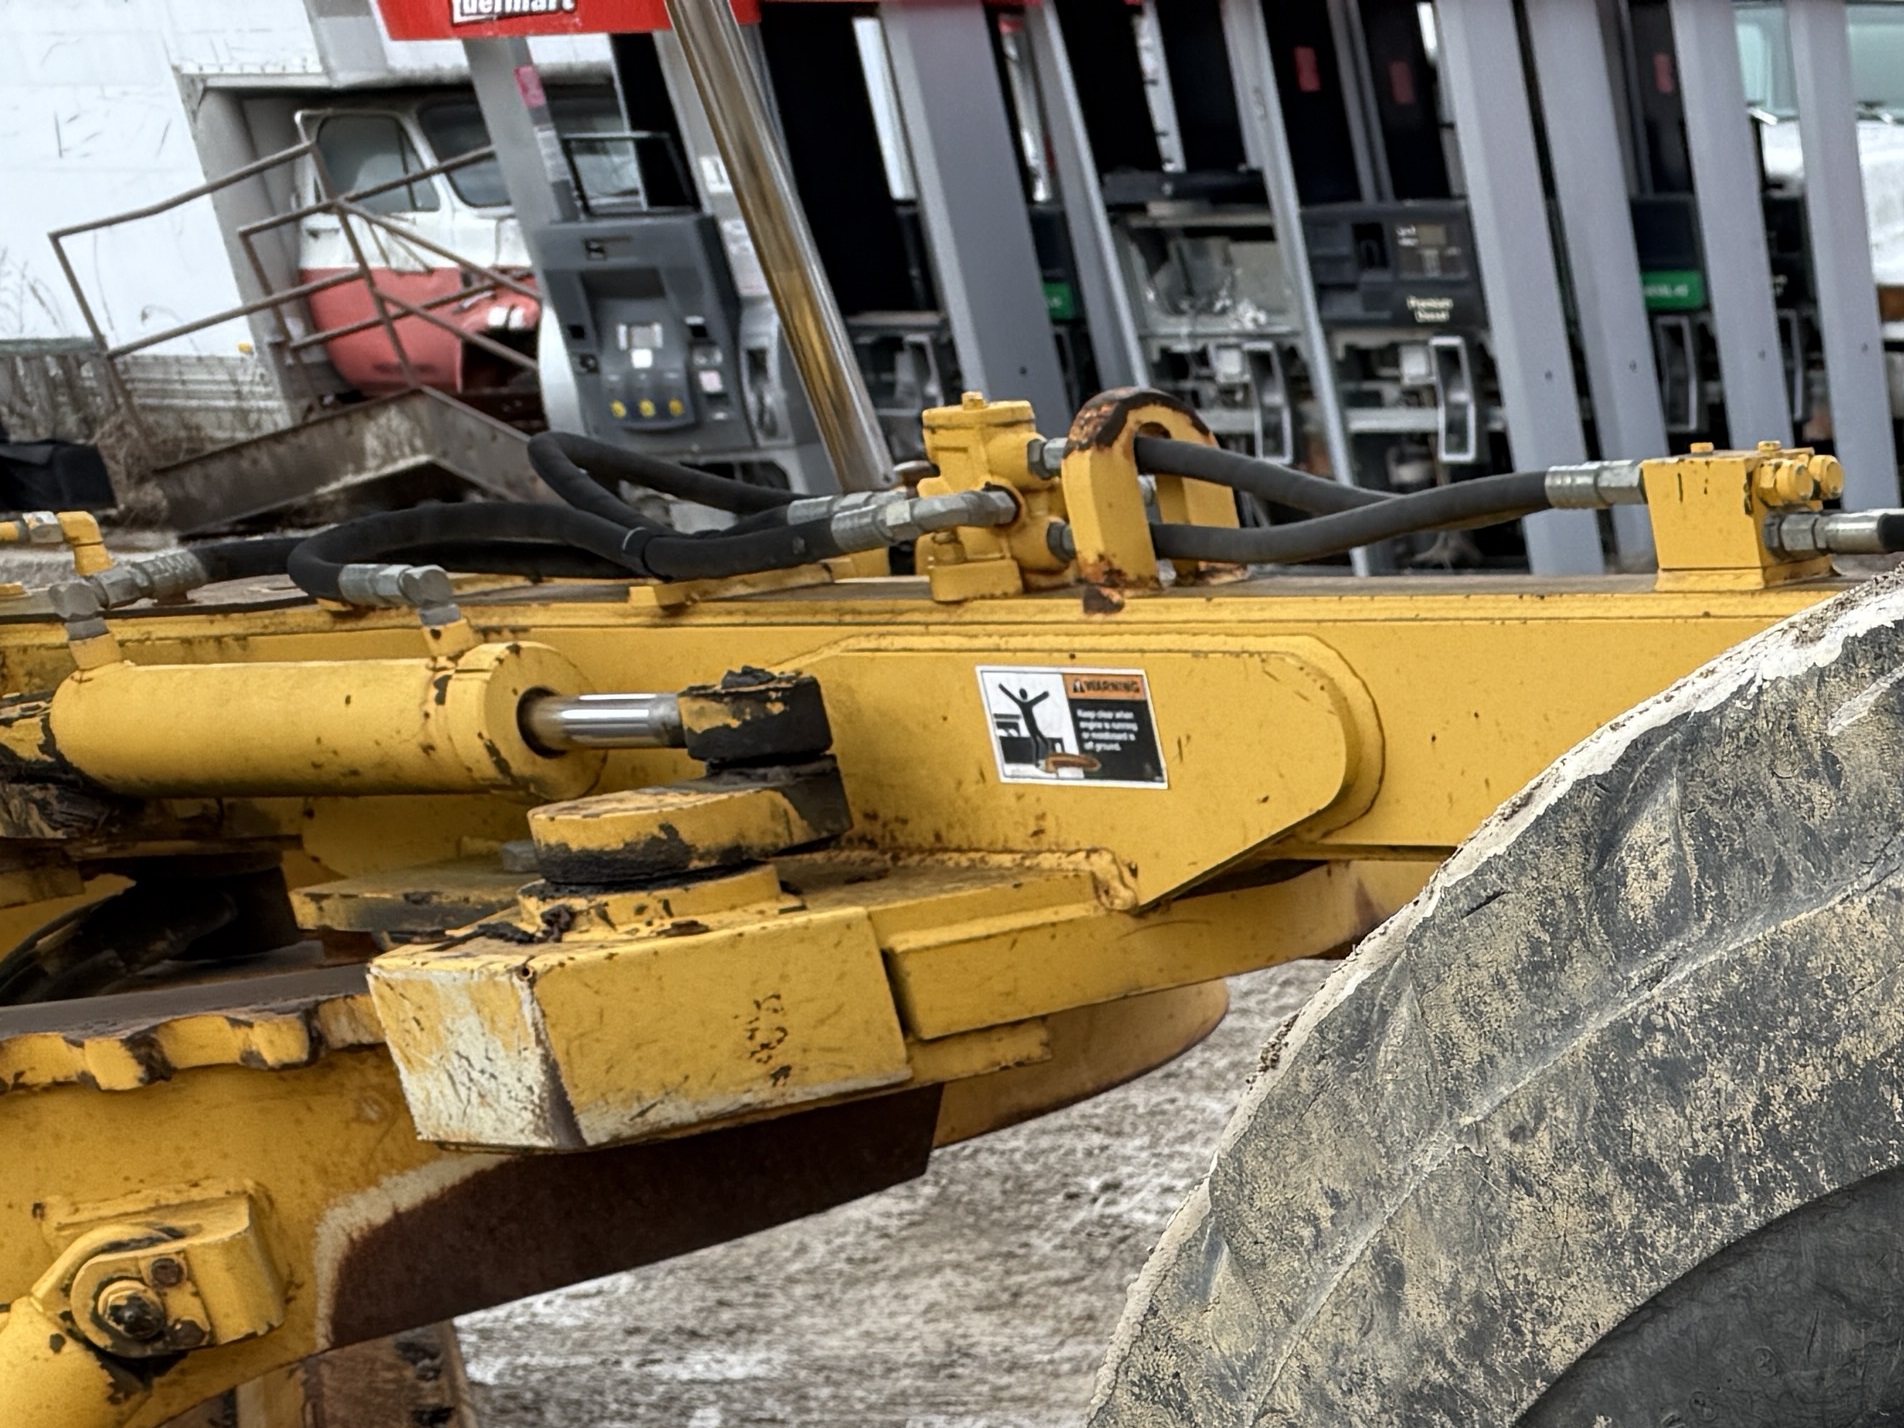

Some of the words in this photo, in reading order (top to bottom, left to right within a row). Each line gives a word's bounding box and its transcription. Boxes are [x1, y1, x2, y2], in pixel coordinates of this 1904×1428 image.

[1085, 679, 1140, 693] WARNING
[1076, 709, 1095, 720] Keep
[1096, 709, 1114, 719] clear
[1115, 710, 1134, 719] when
[1079, 722, 1102, 731] engine
[1112, 722, 1138, 731] running
